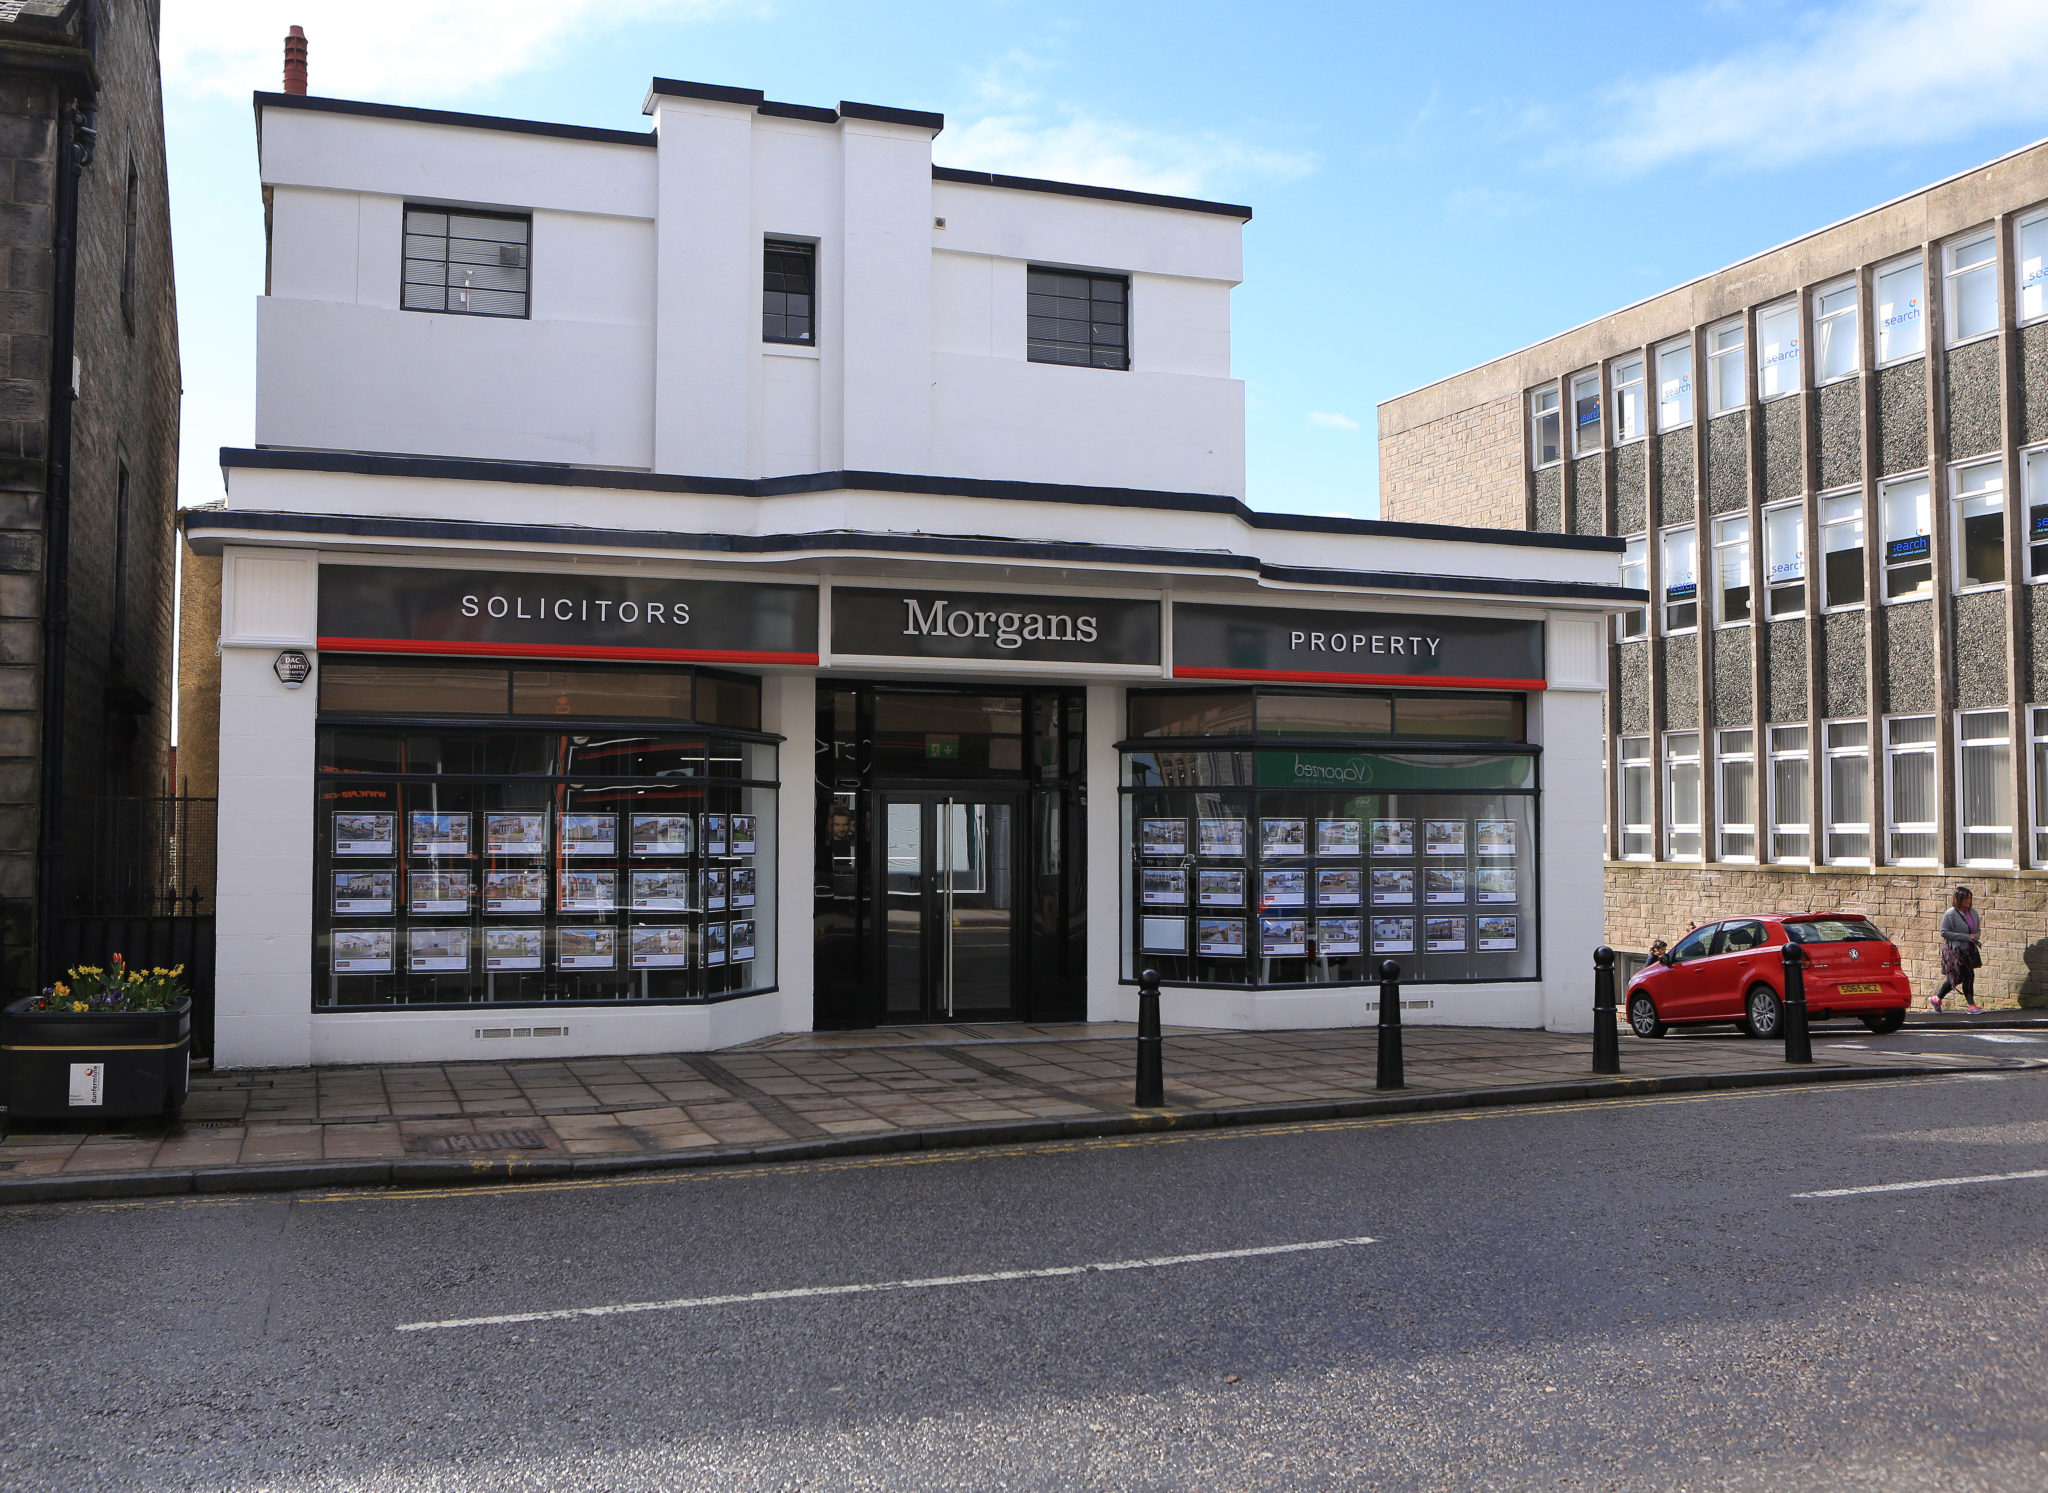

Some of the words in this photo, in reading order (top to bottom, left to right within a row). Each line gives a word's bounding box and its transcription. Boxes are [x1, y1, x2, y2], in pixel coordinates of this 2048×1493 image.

[1884, 308, 1920, 327] search
[1766, 347, 1800, 364] search
[1664, 382, 1691, 398] search
[1891, 537, 1927, 553] search
[461, 595, 690, 625] SOLICITORS
[903, 599, 1098, 649] Morgans
[1290, 631, 1440, 656] PROPERTY
